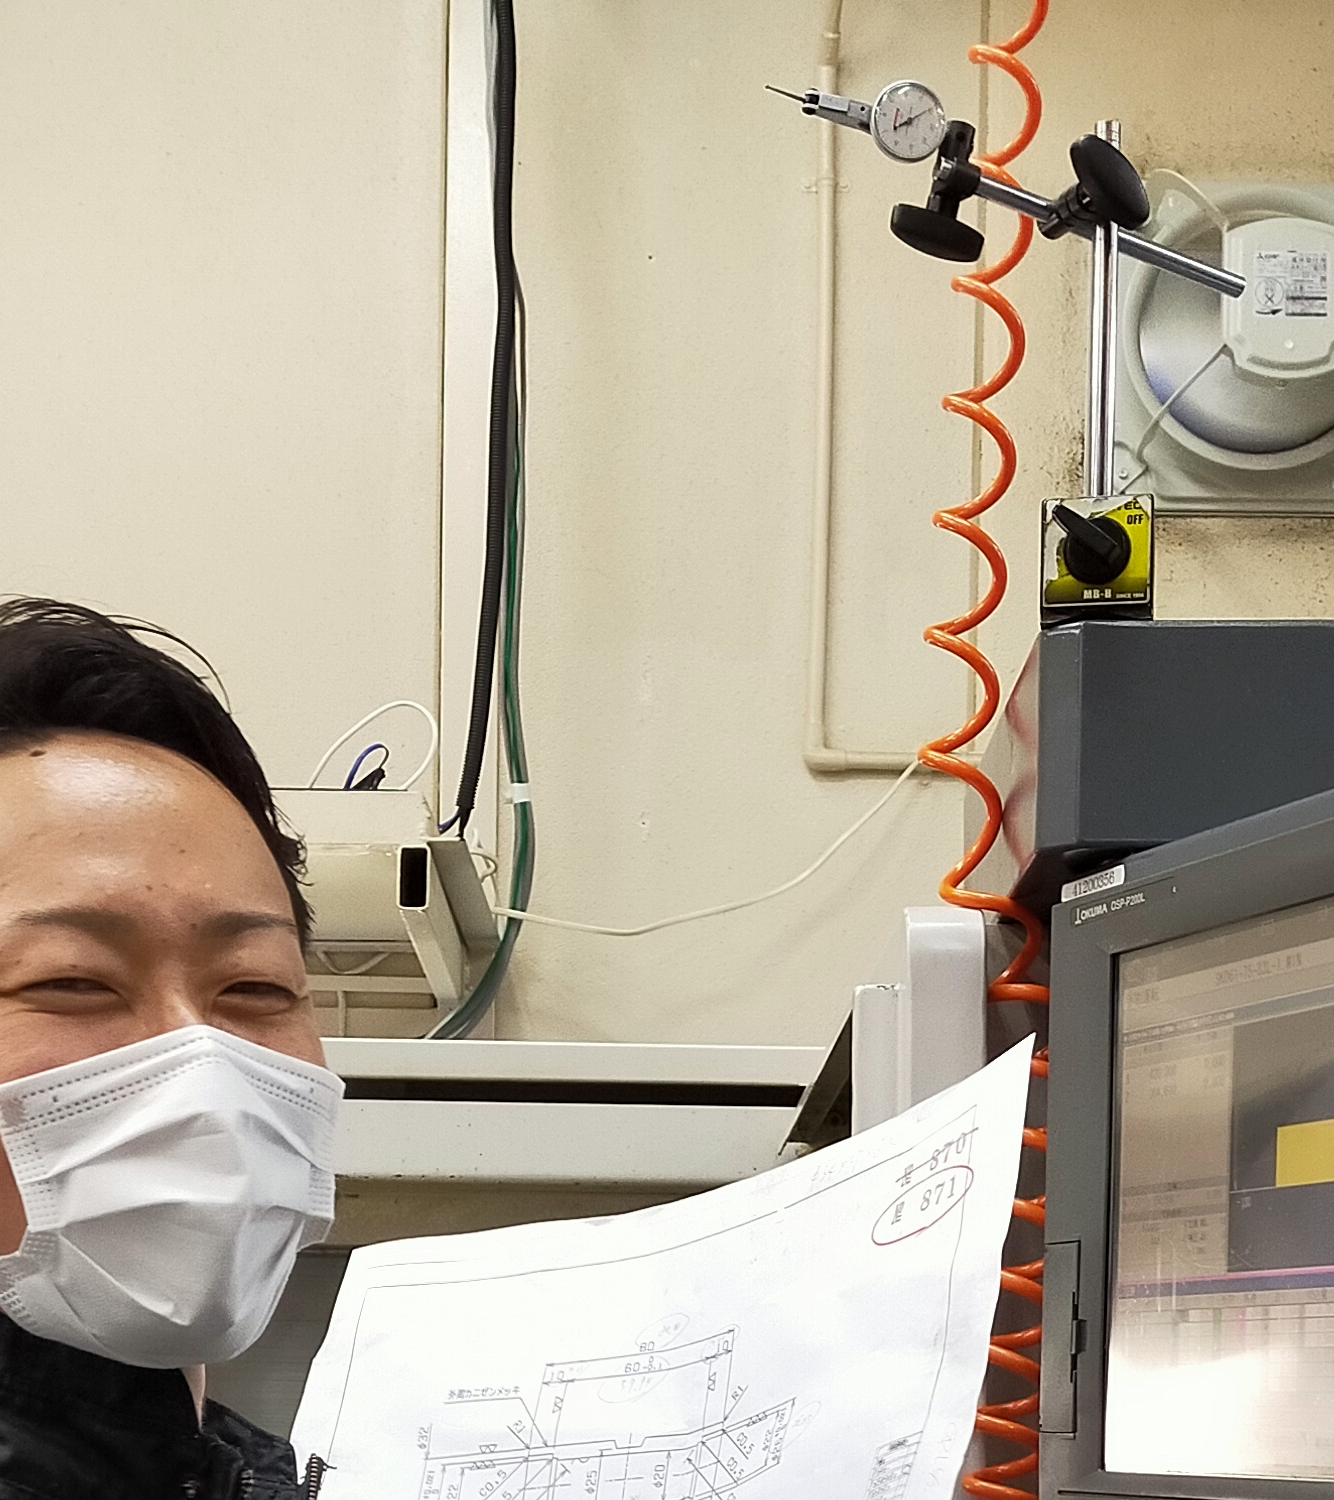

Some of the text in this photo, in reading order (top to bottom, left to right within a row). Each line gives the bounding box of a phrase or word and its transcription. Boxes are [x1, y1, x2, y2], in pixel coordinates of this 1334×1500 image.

[1127, 514, 1143, 524] OFF
[1081, 903, 1108, 920] OKUMA
[920, 1174, 956, 1211] 871
